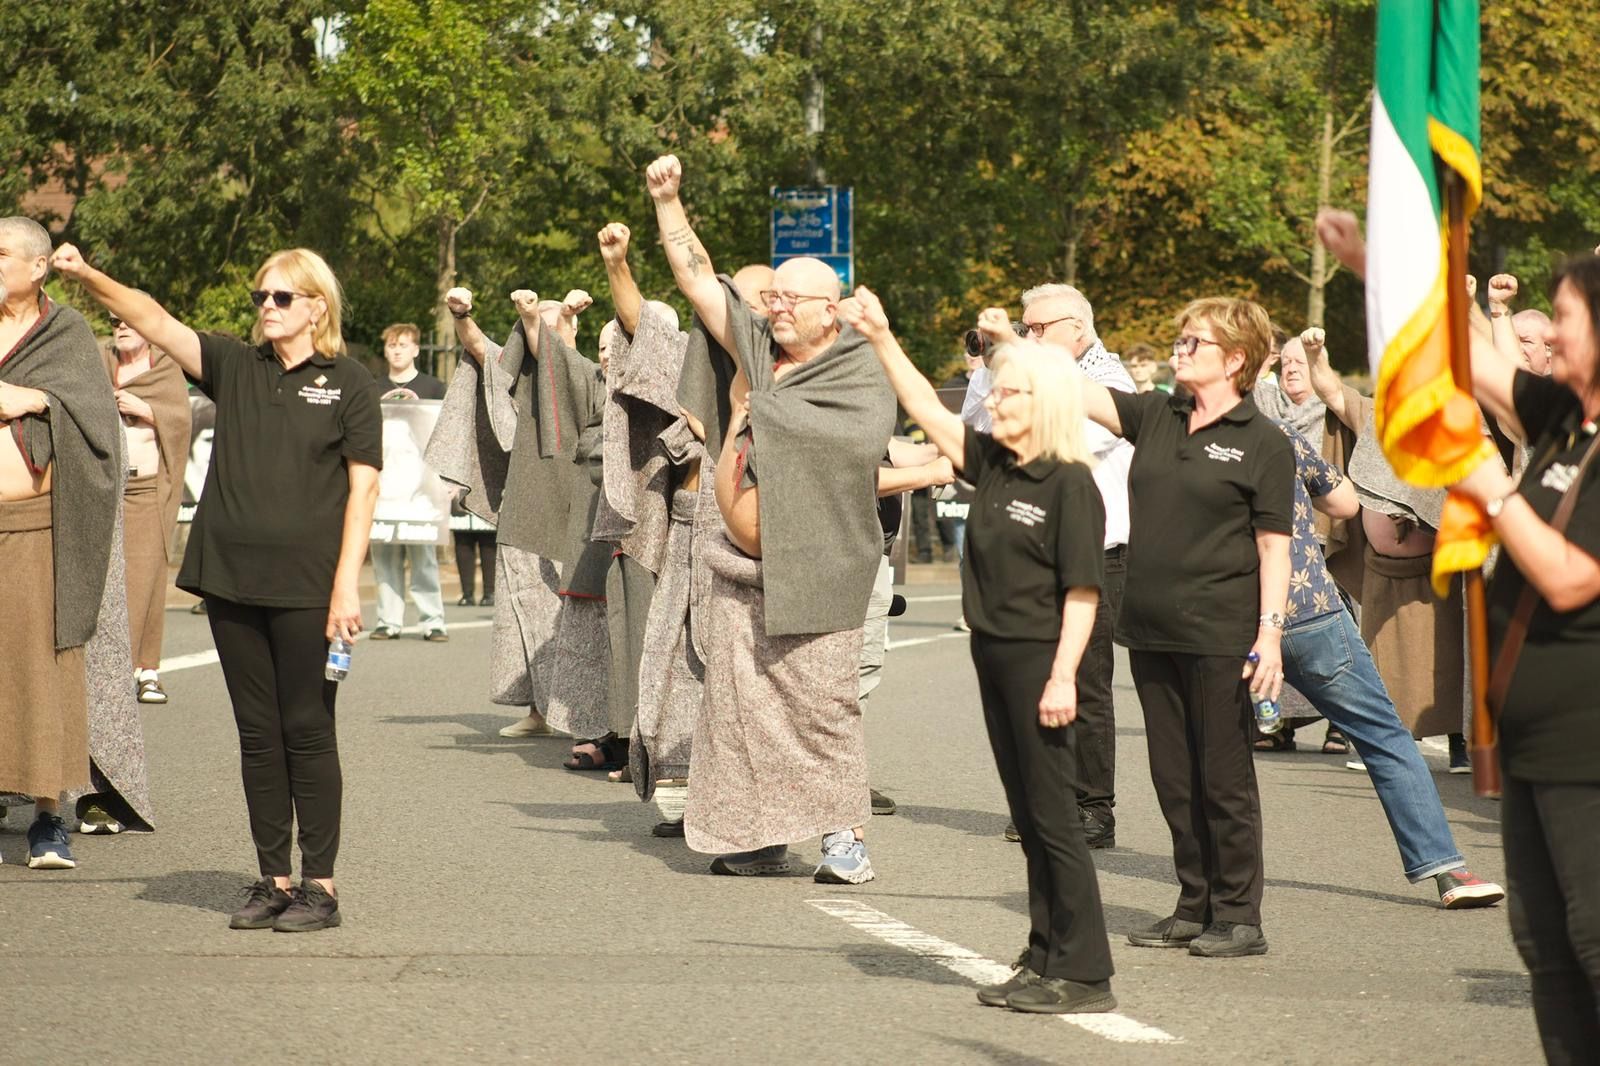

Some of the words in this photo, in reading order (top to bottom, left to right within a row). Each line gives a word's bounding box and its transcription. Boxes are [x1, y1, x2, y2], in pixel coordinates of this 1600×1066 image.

[777, 228, 824, 238] permitted
[790, 240, 810, 249] taxi
[937, 502, 970, 519] Patsy
